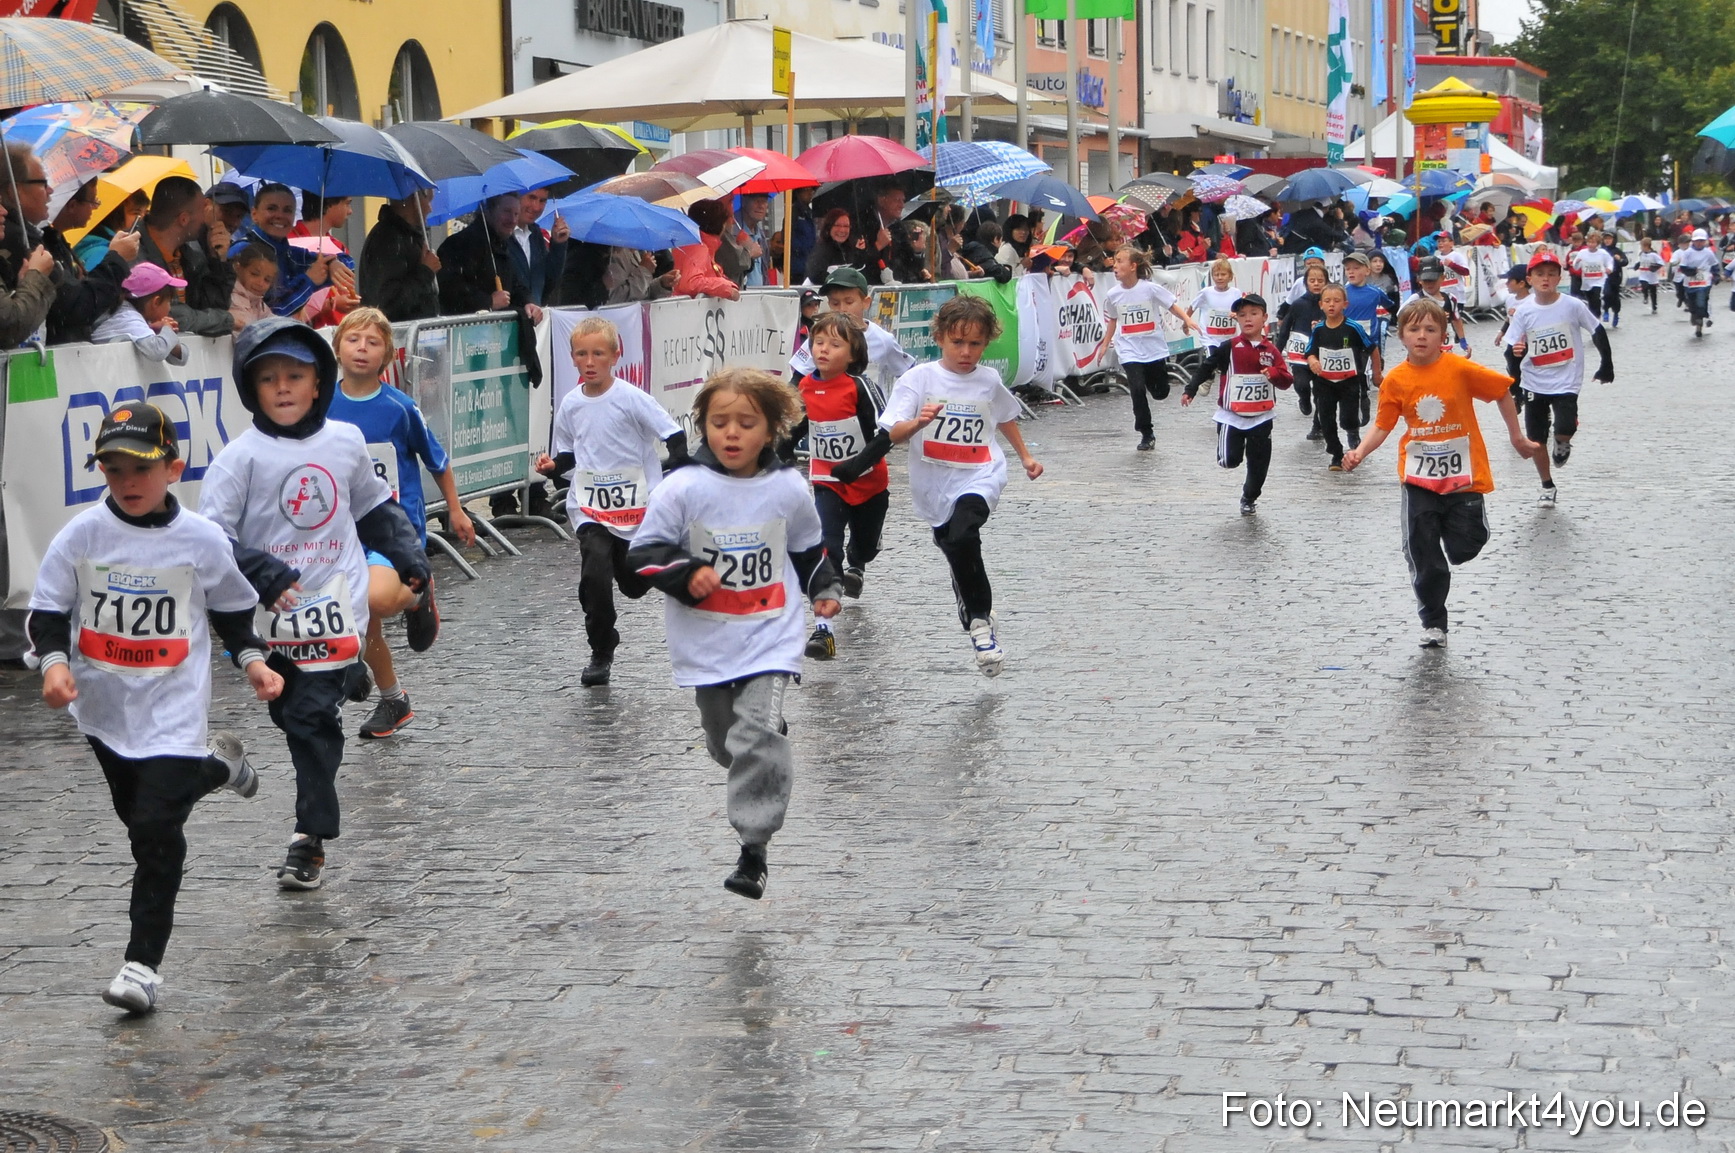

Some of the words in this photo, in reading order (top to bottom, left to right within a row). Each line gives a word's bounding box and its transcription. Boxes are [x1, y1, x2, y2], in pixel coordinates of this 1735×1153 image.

[1121, 310, 1150, 325] 7197
[1210, 316, 1233, 327] 7061
[663, 335, 702, 367] RECHTS
[1532, 334, 1567, 355] 7346
[1323, 358, 1350, 371] 7236
[455, 391, 466, 414] Fun
[474, 386, 495, 410] Action
[495, 385, 502, 407] in
[1235, 385, 1269, 401] 7255
[126, 425, 148, 433] Diesel
[454, 422, 480, 449] sicheren
[481, 416, 507, 443] Bahnen!
[934, 416, 984, 444] 7252
[62, 377, 229, 506] BCK
[812, 435, 859, 460] 7262
[1413, 453, 1463, 477] 7259
[584, 484, 637, 510] 7037
[304, 541, 325, 551] MIT
[713, 532, 760, 546] BOCK
[702, 547, 772, 588] 7298
[108, 572, 157, 587] BOCK
[90, 589, 176, 636] 7120
[270, 601, 345, 639] 7136
[104, 640, 155, 663] Simon
[275, 643, 329, 660] NICLAS
